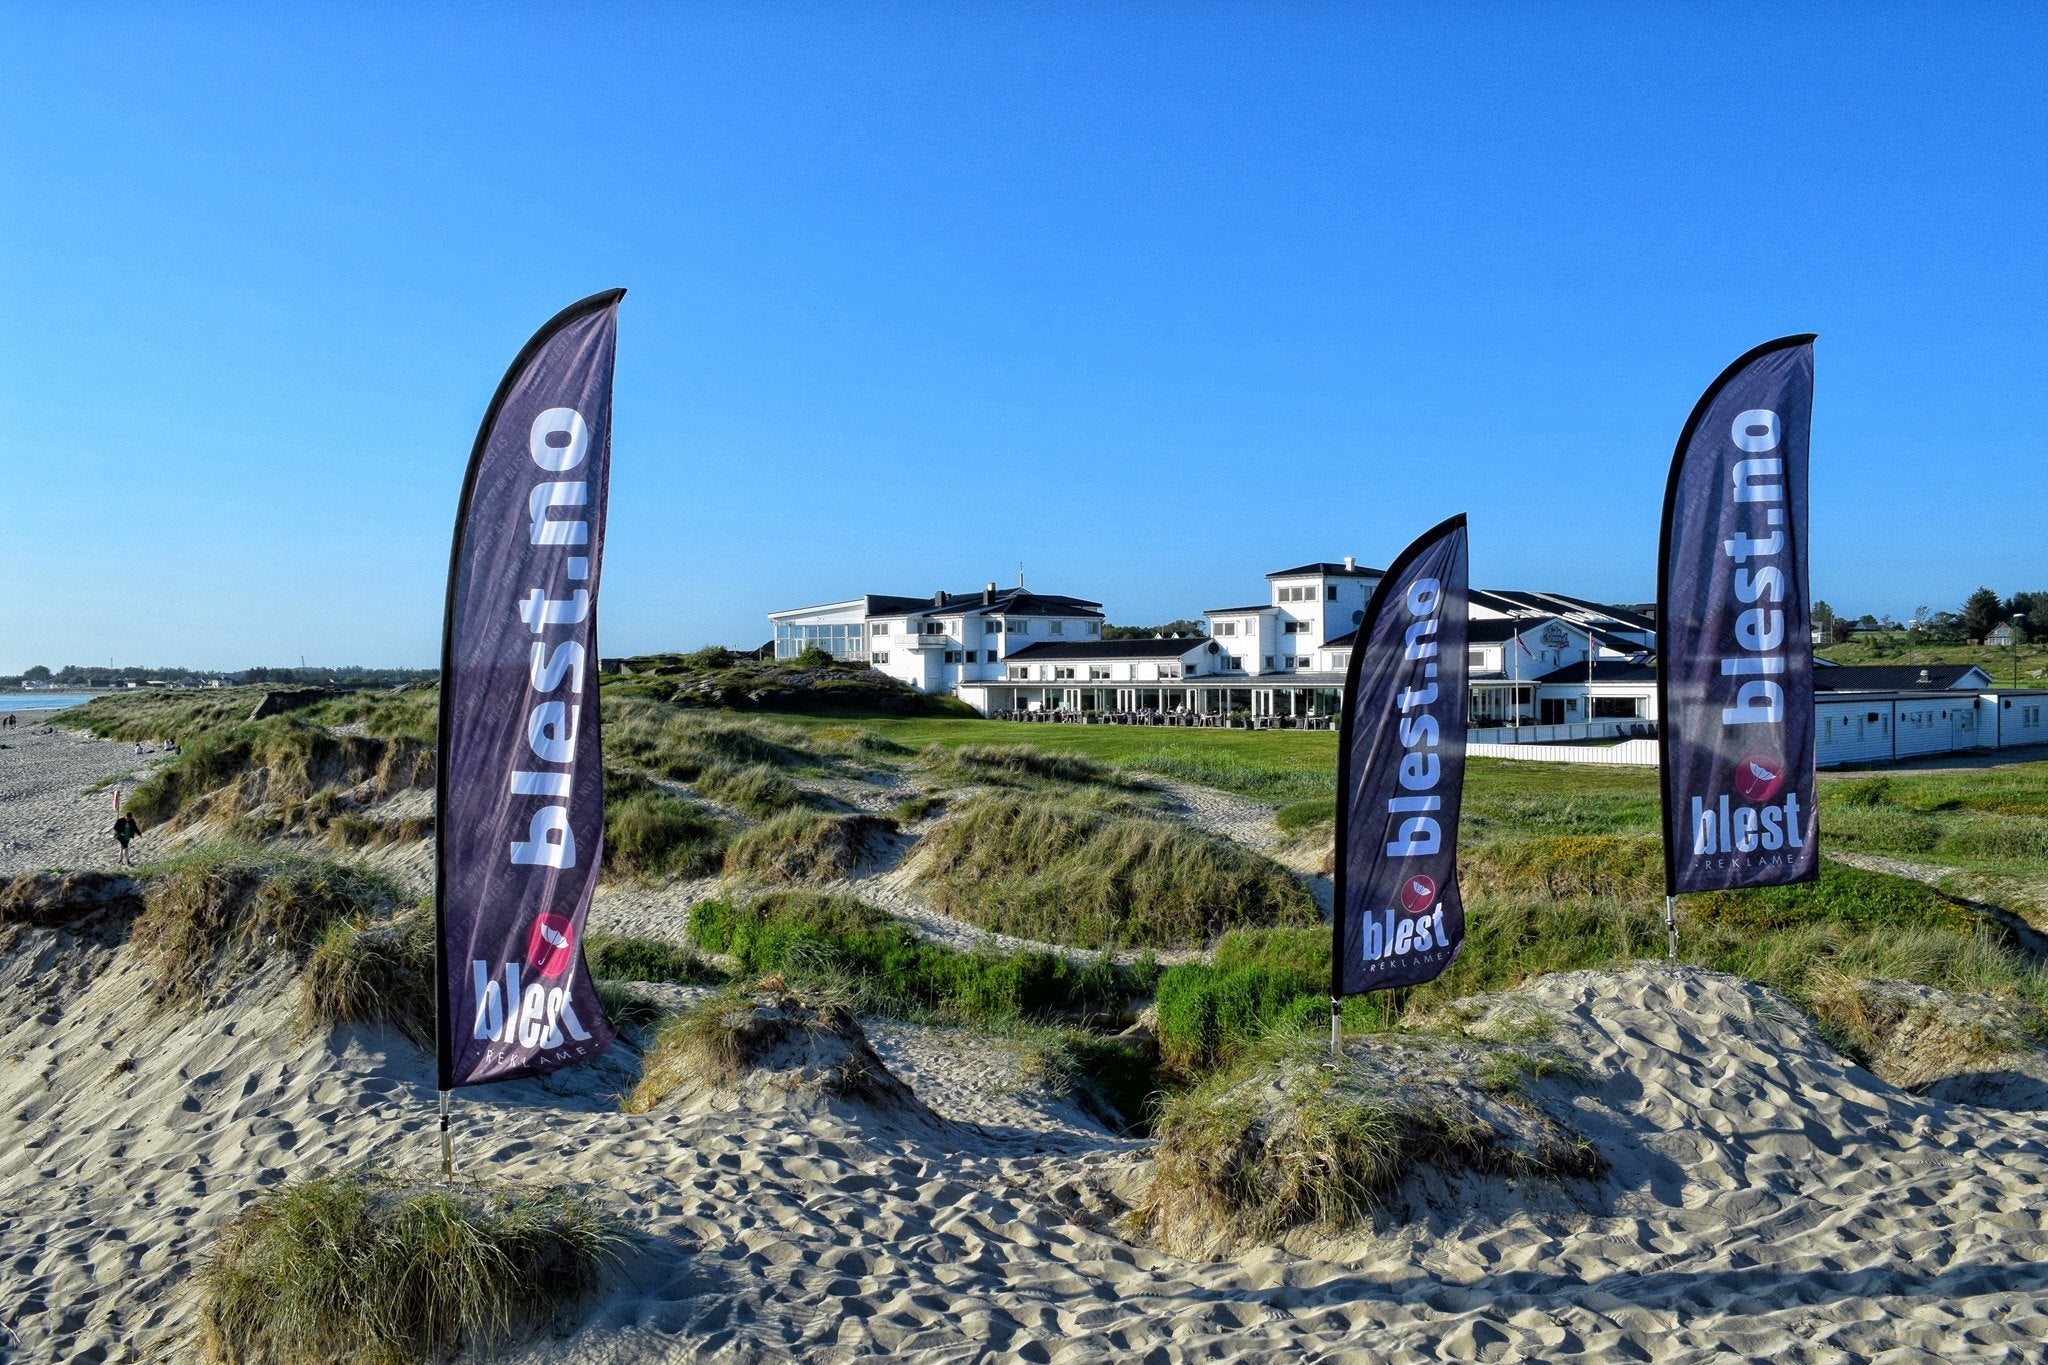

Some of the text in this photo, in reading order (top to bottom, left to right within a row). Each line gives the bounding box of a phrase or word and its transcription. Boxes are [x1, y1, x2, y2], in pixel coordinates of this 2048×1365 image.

[1721, 409, 1785, 725] blest.no
[511, 407, 589, 869] blest.no
[1386, 577, 1441, 857] blest.no
[1692, 792, 1804, 855] blest
[1705, 853, 1794, 870] REKLAME
[1362, 901, 1449, 961] blest
[1370, 953, 1443, 973] REKLAME
[473, 959, 592, 1050] blest
[486, 1046, 588, 1069] REKLAME
